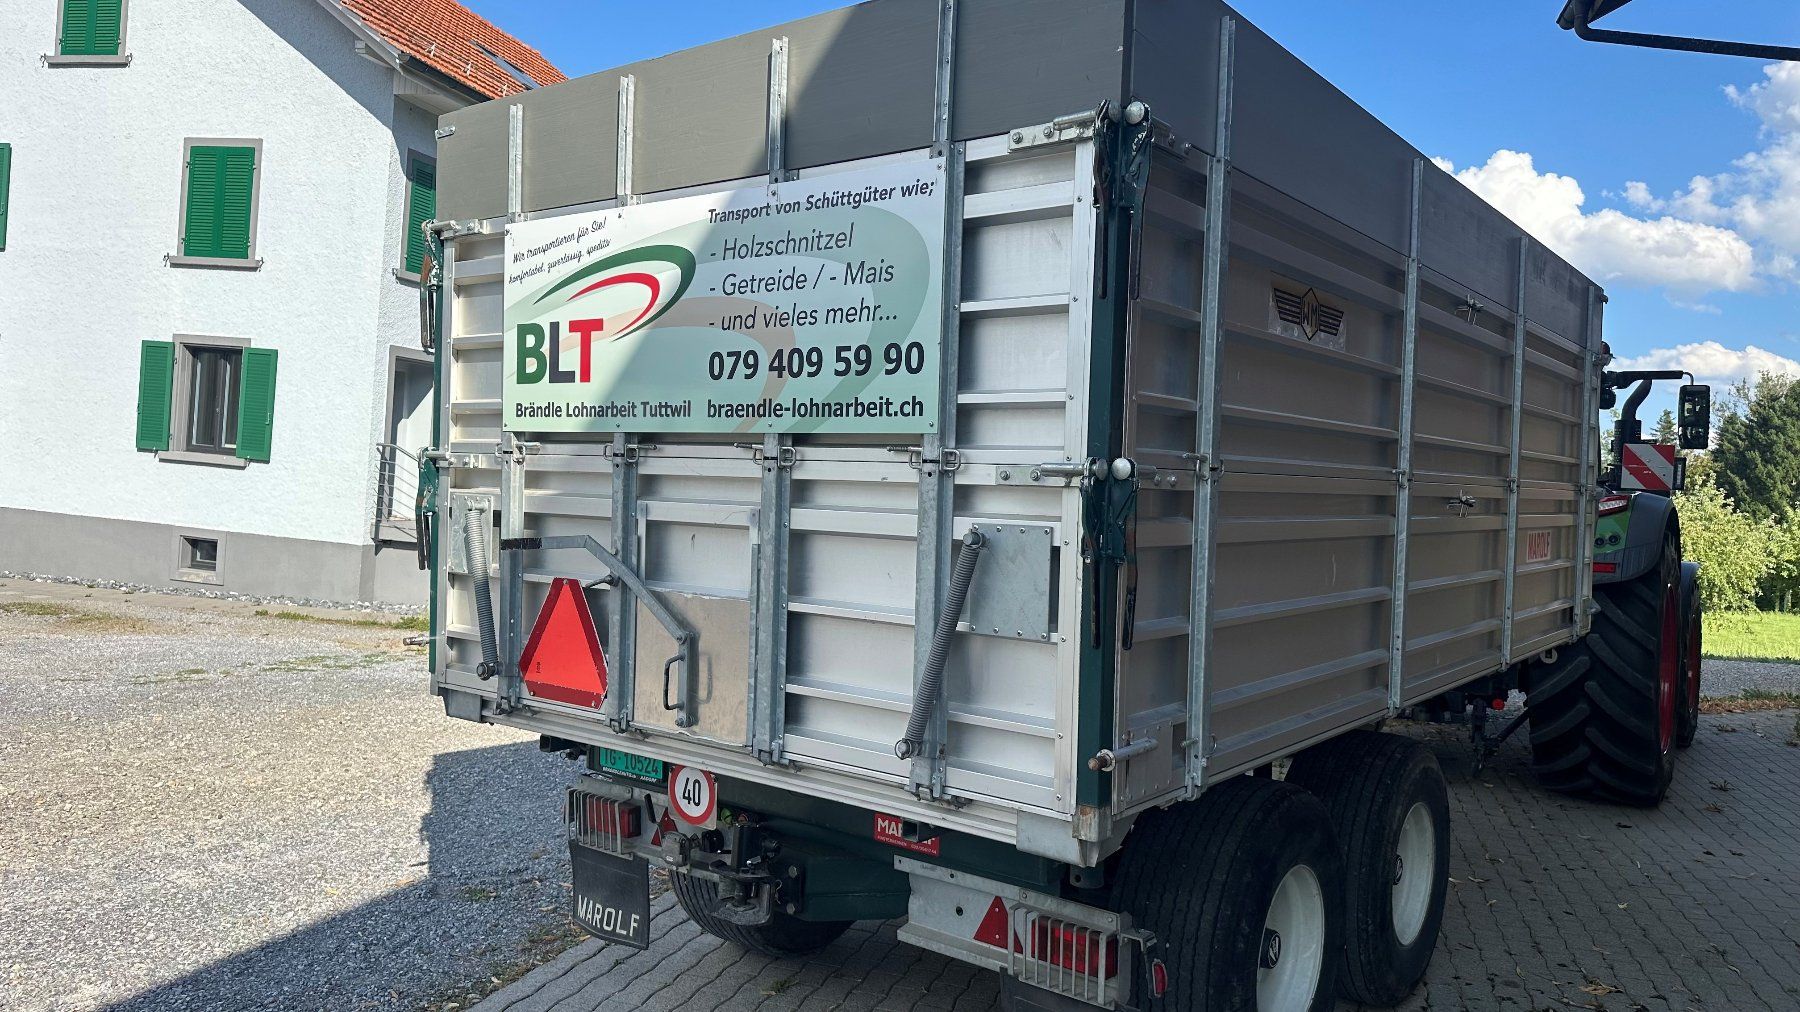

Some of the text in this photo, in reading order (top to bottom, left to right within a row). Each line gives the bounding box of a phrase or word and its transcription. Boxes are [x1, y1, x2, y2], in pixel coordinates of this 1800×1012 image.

[708, 202, 771, 224] Transport
[775, 200, 800, 215] von
[805, 185, 896, 211] Schüttgüter
[513, 216, 607, 264] Wir transportieren für Sie!
[722, 221, 855, 261] Holzschnitzel
[722, 266, 808, 296] Getreide
[843, 258, 895, 286] Mais
[721, 305, 758, 331] und
[763, 302, 818, 328] vieles
[825, 297, 897, 325] mehr...
[516, 317, 604, 385] BLT
[708, 341, 925, 381] 079 409 59 90
[515, 400, 691, 419] Brändle Lohnarbeit Tuttwil
[707, 396, 924, 419] braendle-lohnarbeit.ch
[1528, 531, 1551, 561] MAROLF
[682, 777, 702, 807] 40
[577, 894, 640, 937] MAROLF
